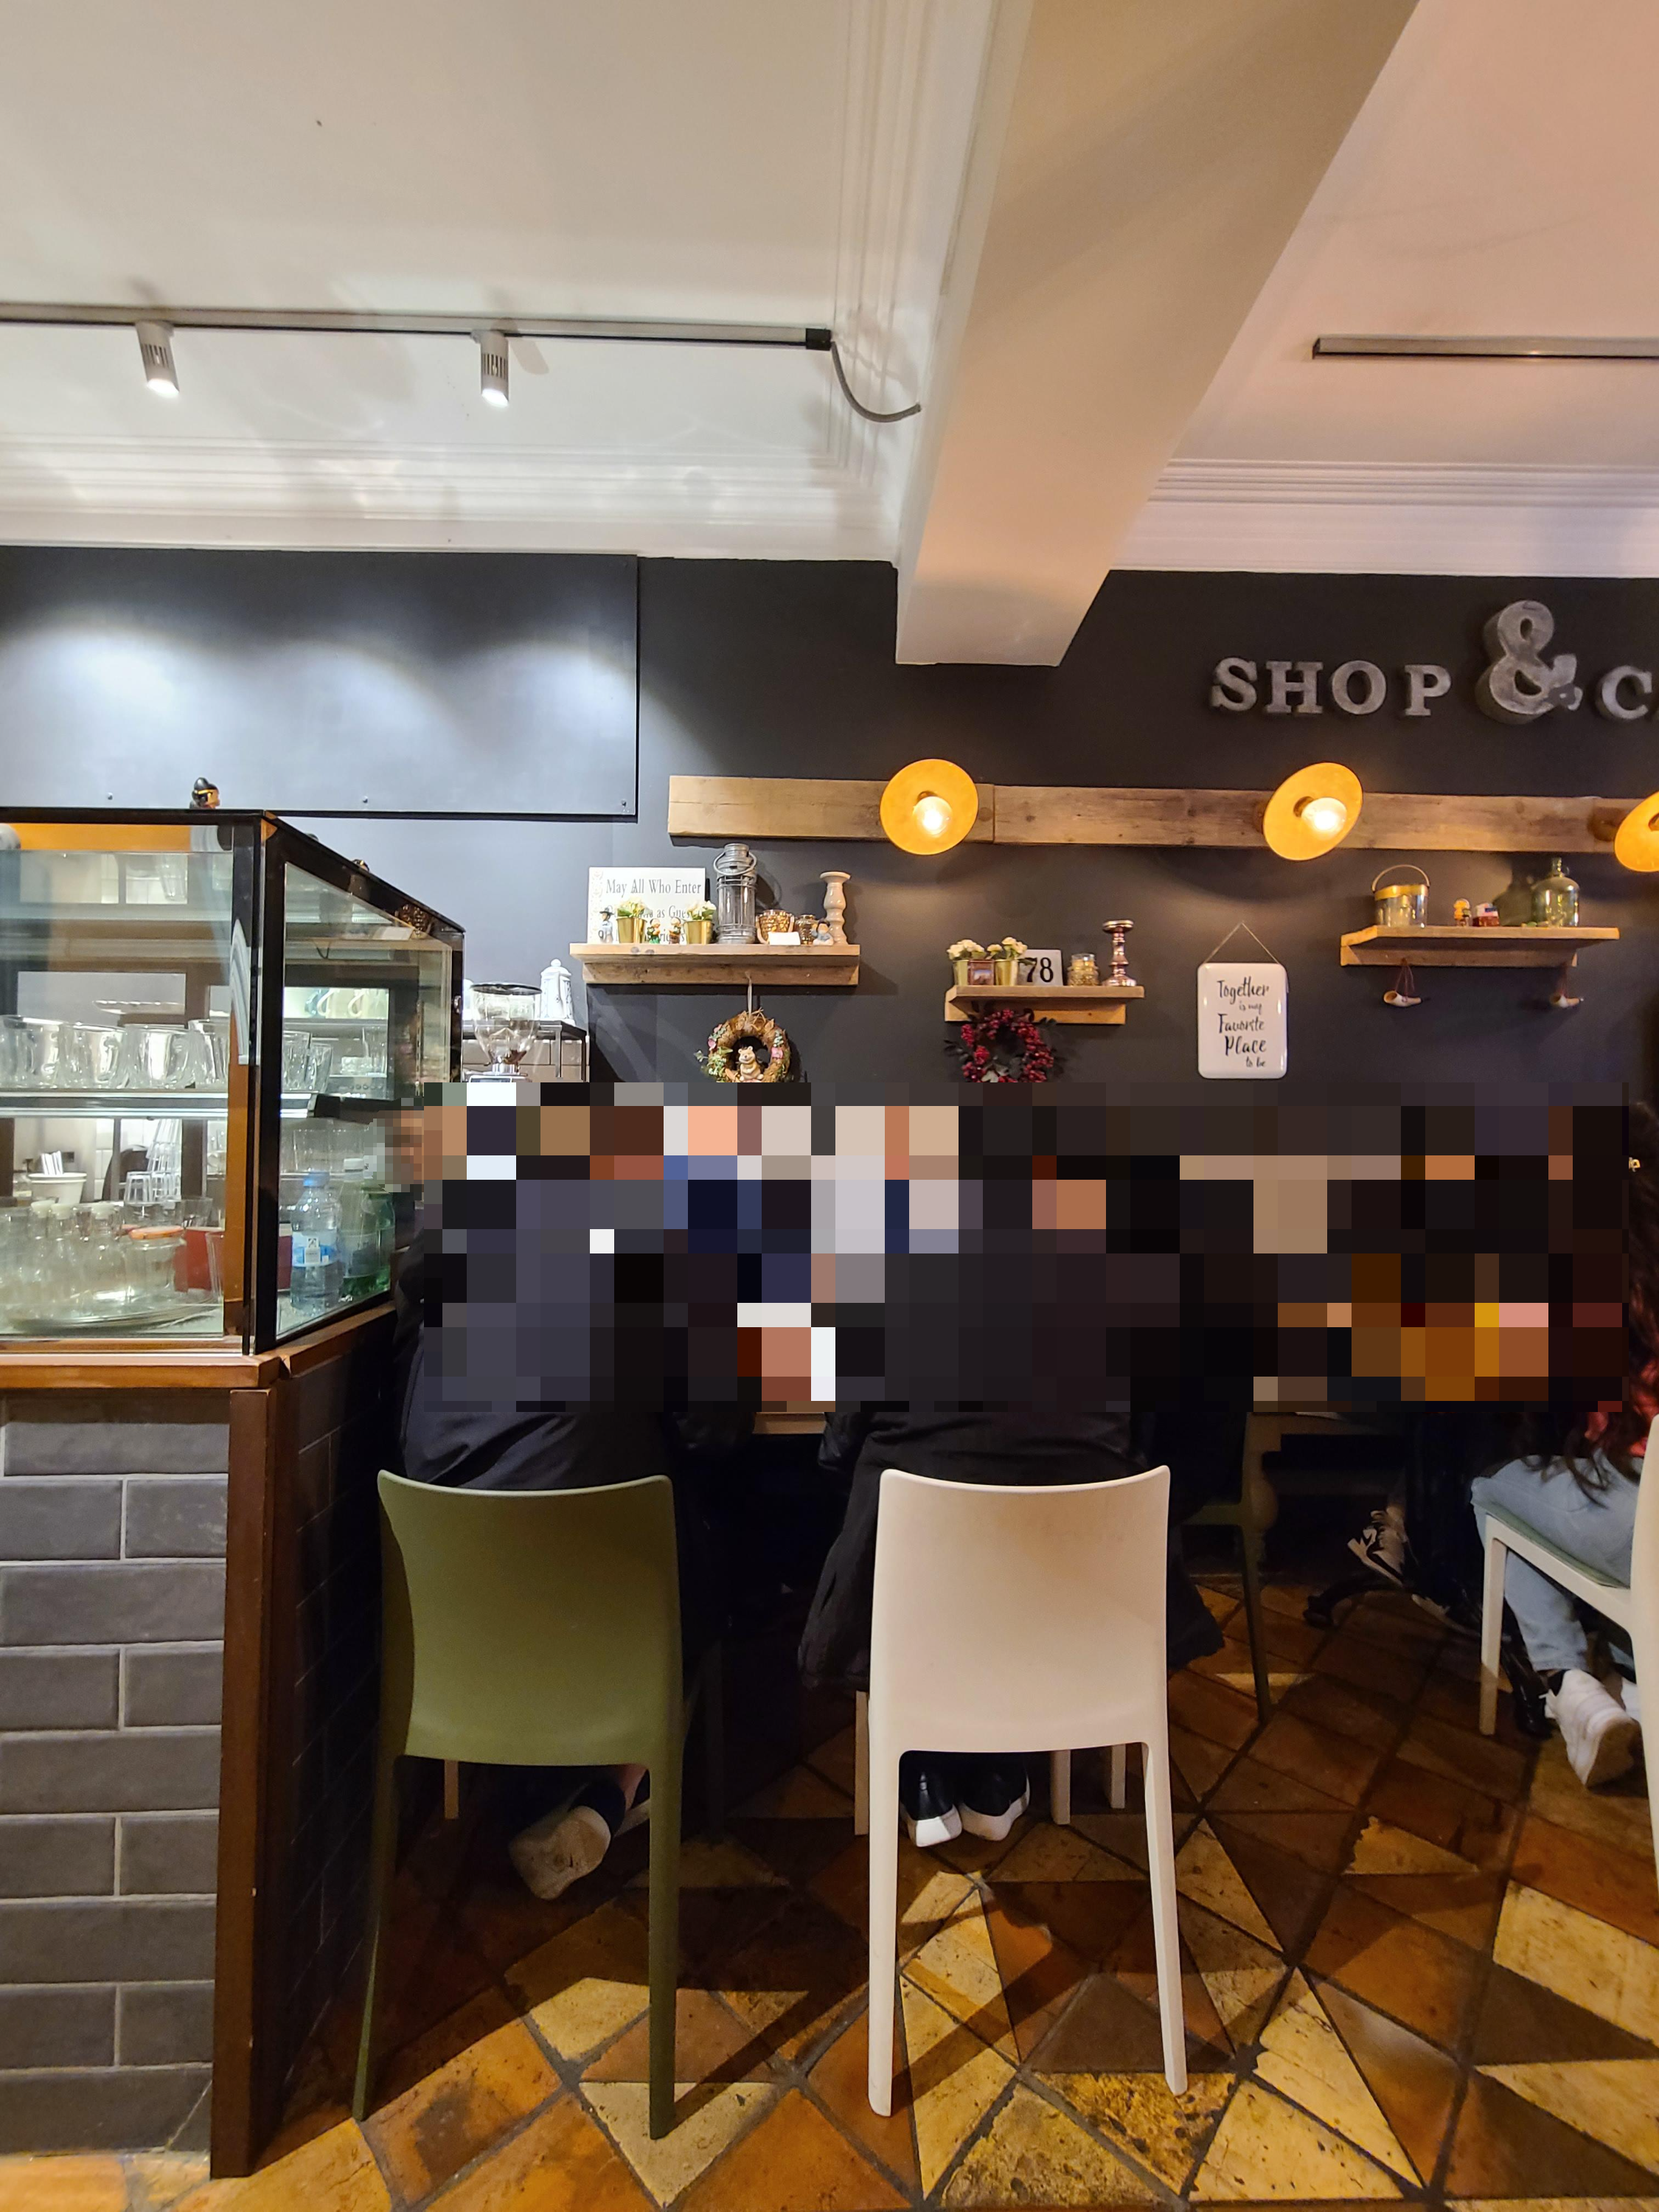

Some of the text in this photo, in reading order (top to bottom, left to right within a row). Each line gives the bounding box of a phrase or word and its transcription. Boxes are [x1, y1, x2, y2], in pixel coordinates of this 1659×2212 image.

[1210, 599, 1659, 725] SHOP & C
[606, 879, 702, 898] May All Who Enter
[656, 908, 665, 918] as
[1024, 957, 1054, 983] 78
[1217, 976, 1269, 1005] Together
[1239, 1001, 1262, 1015] is my
[1217, 1012, 1265, 1033] Favorite
[1225, 1035, 1267, 1056] Place
[1245, 1056, 1266, 1067] to be
